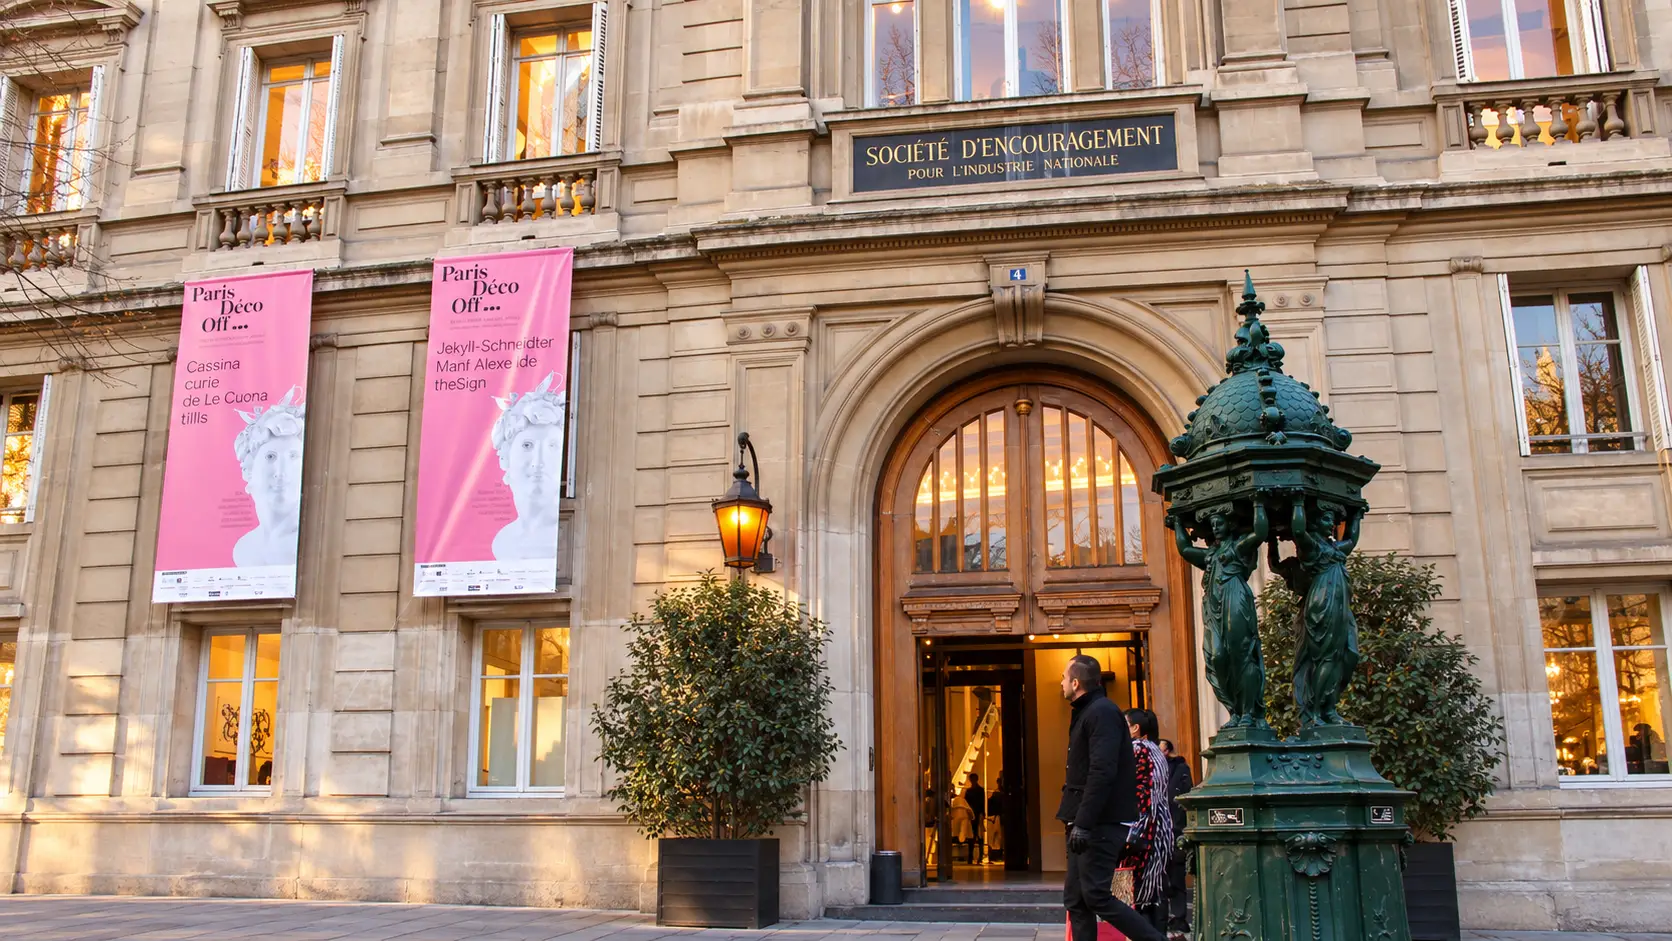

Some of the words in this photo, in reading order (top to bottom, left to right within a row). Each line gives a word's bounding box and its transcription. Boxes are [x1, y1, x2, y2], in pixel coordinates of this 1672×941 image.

[866, 137, 950, 166] SOCIÉTÉ
[961, 125, 1164, 158] D'ENCOURAGEMENT
[908, 167, 944, 180] POUR
[953, 161, 1034, 177] L'INDUSTRIE
[1044, 154, 1119, 170] NATIONALE
[442, 264, 488, 282] Paris
[1013, 269, 1022, 280] 4
[192, 284, 235, 302] Paris
[472, 279, 519, 296] Déco
[220, 299, 263, 315] Déco
[186, 358, 240, 373] Cassina
[436, 359, 470, 373] Manf
[184, 376, 220, 390] curie
[434, 376, 487, 392] theSign
[182, 394, 200, 407] de
[204, 393, 221, 406] Le
[224, 390, 268, 404] Cuona
